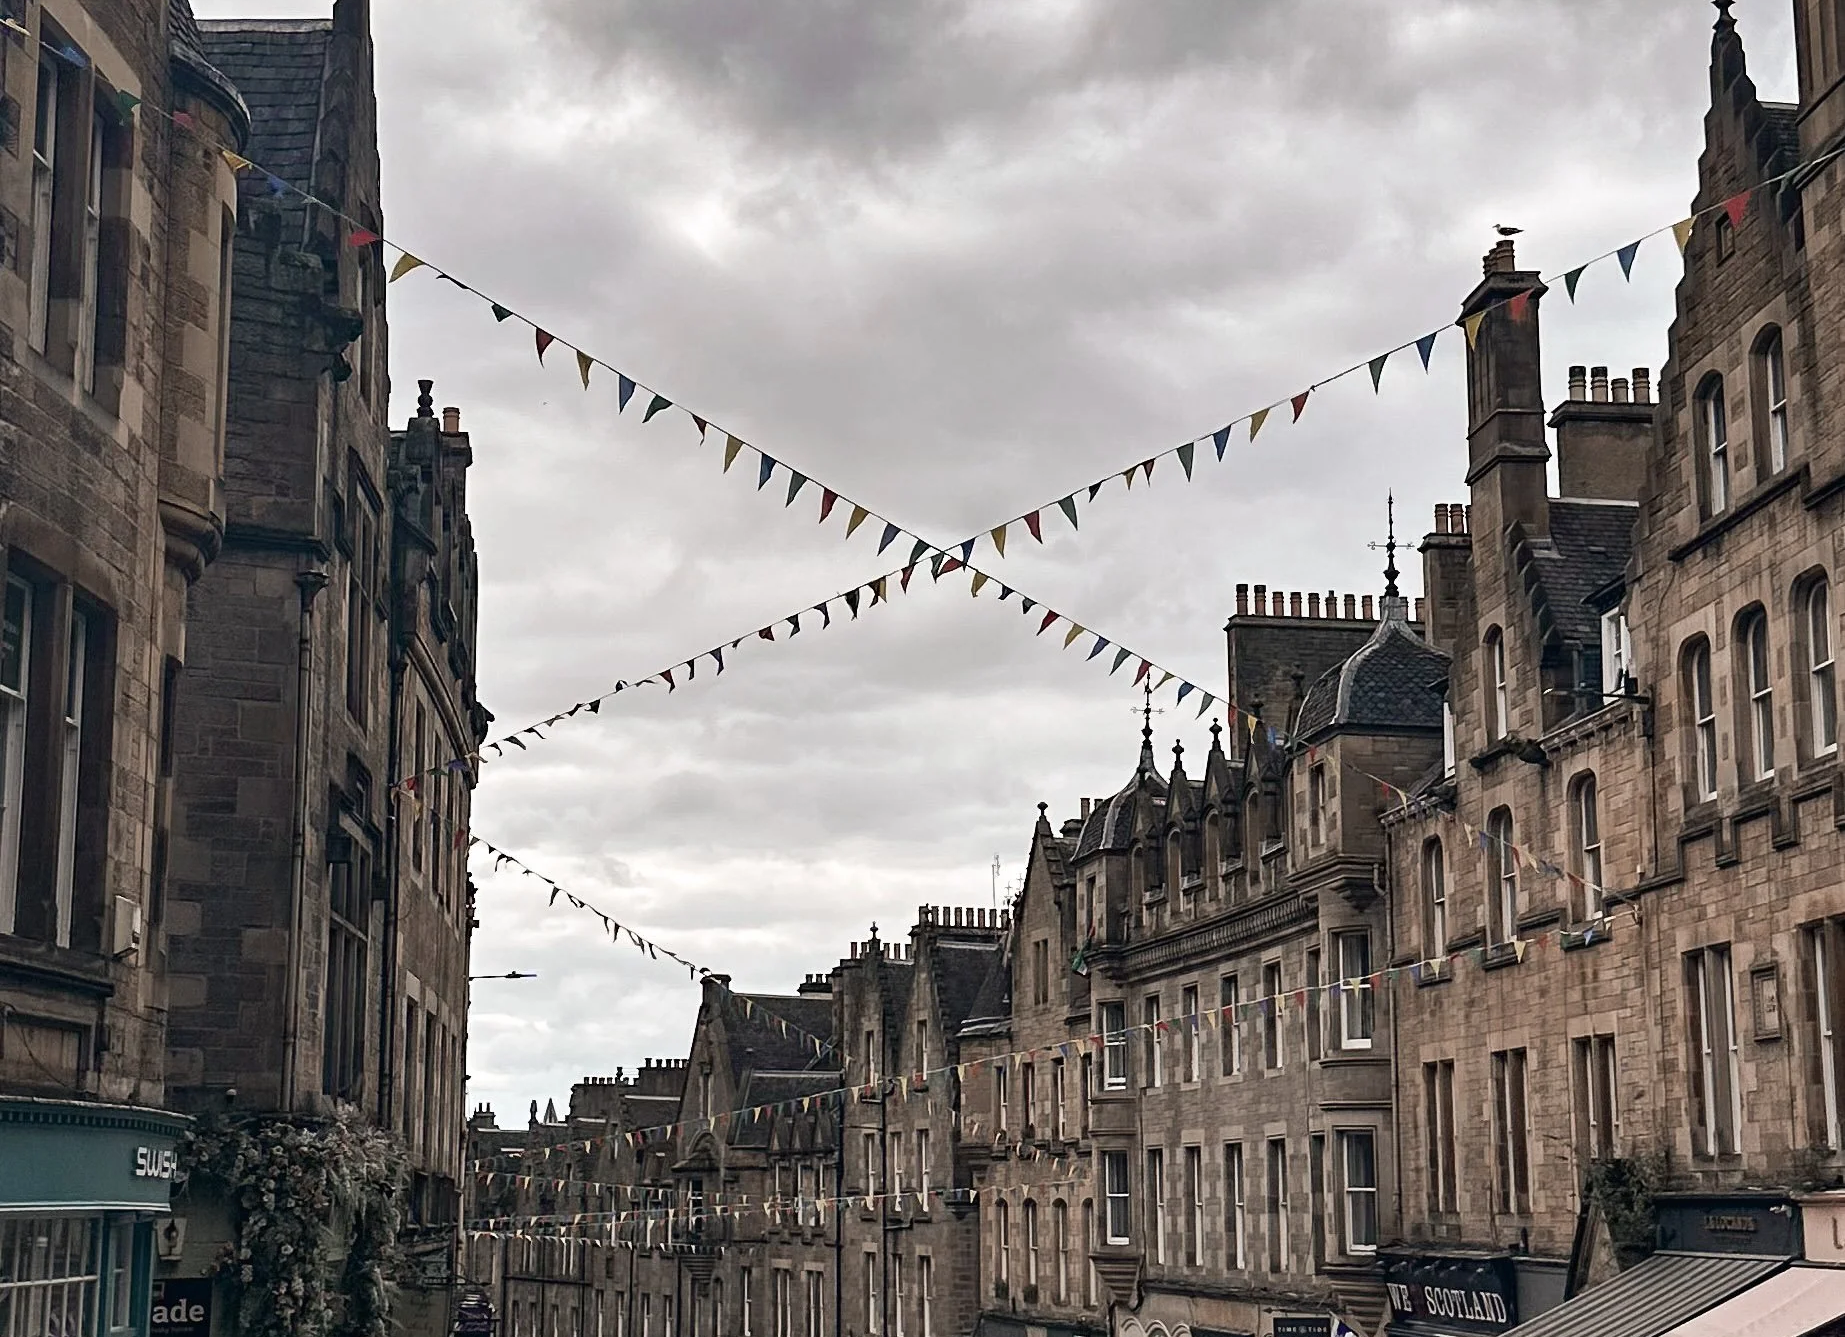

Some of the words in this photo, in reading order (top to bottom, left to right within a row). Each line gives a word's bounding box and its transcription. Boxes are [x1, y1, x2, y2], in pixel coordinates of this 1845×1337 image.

[136, 1147, 178, 1179] SWISH
[1386, 1282, 1412, 1313] WE
[1424, 1285, 1507, 1323] SCOTLAND
